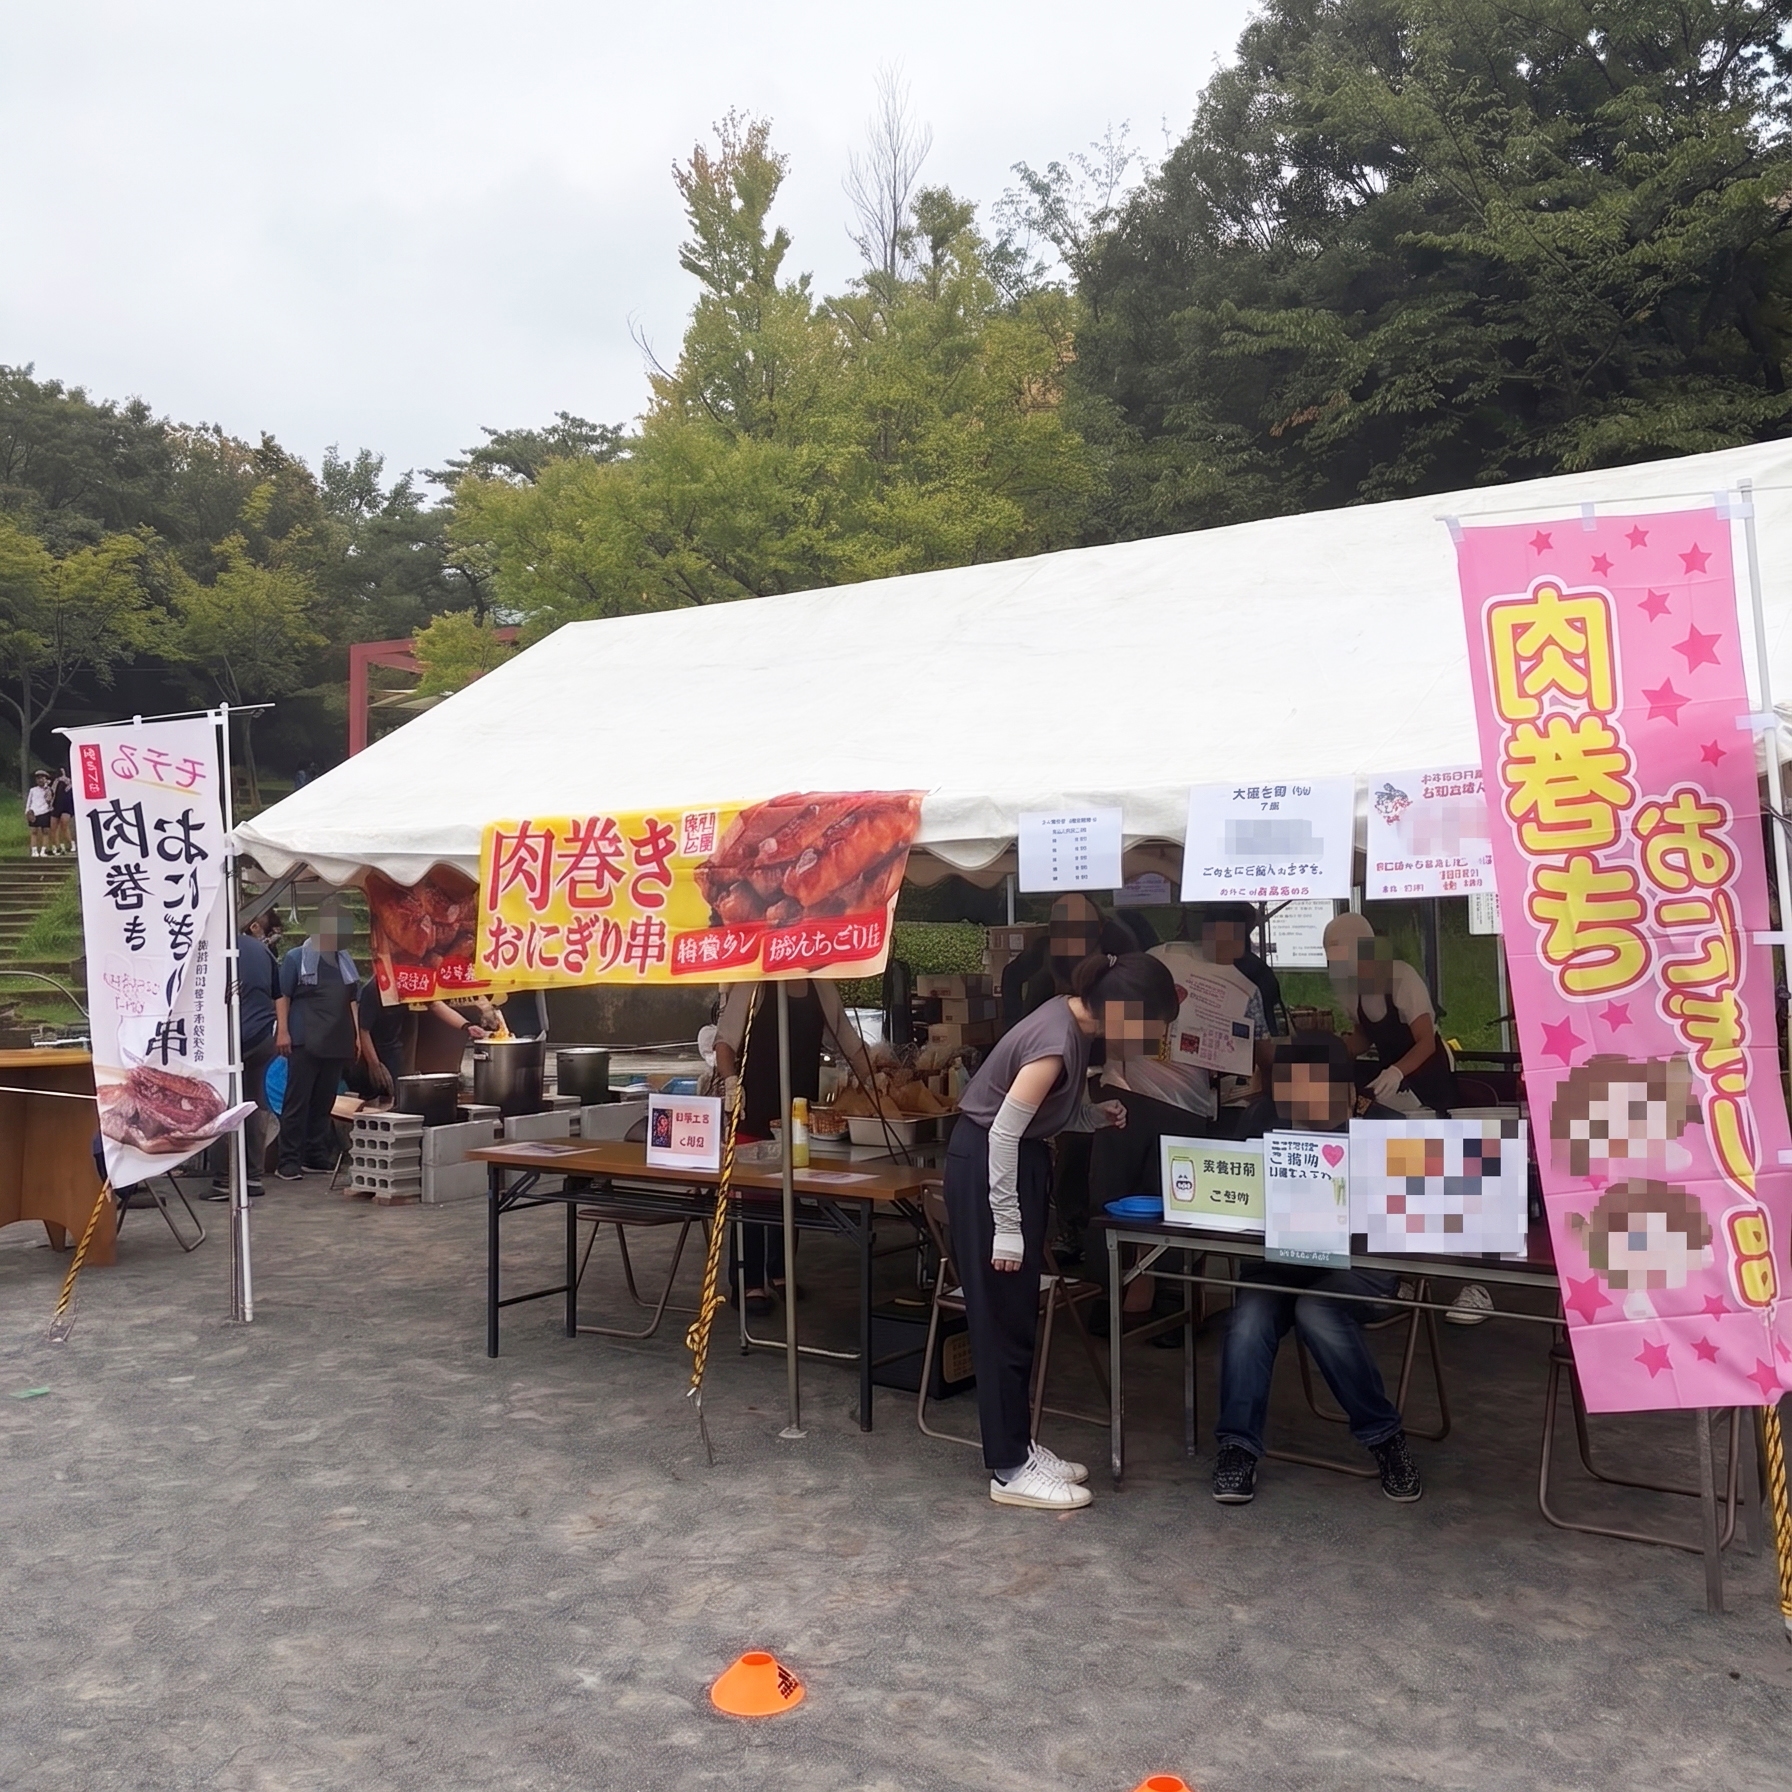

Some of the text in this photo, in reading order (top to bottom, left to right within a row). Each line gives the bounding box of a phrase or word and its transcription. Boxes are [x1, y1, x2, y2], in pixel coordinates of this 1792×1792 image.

[488, 816, 677, 912] 肉巻き
[483, 914, 667, 975] おにぎり串
